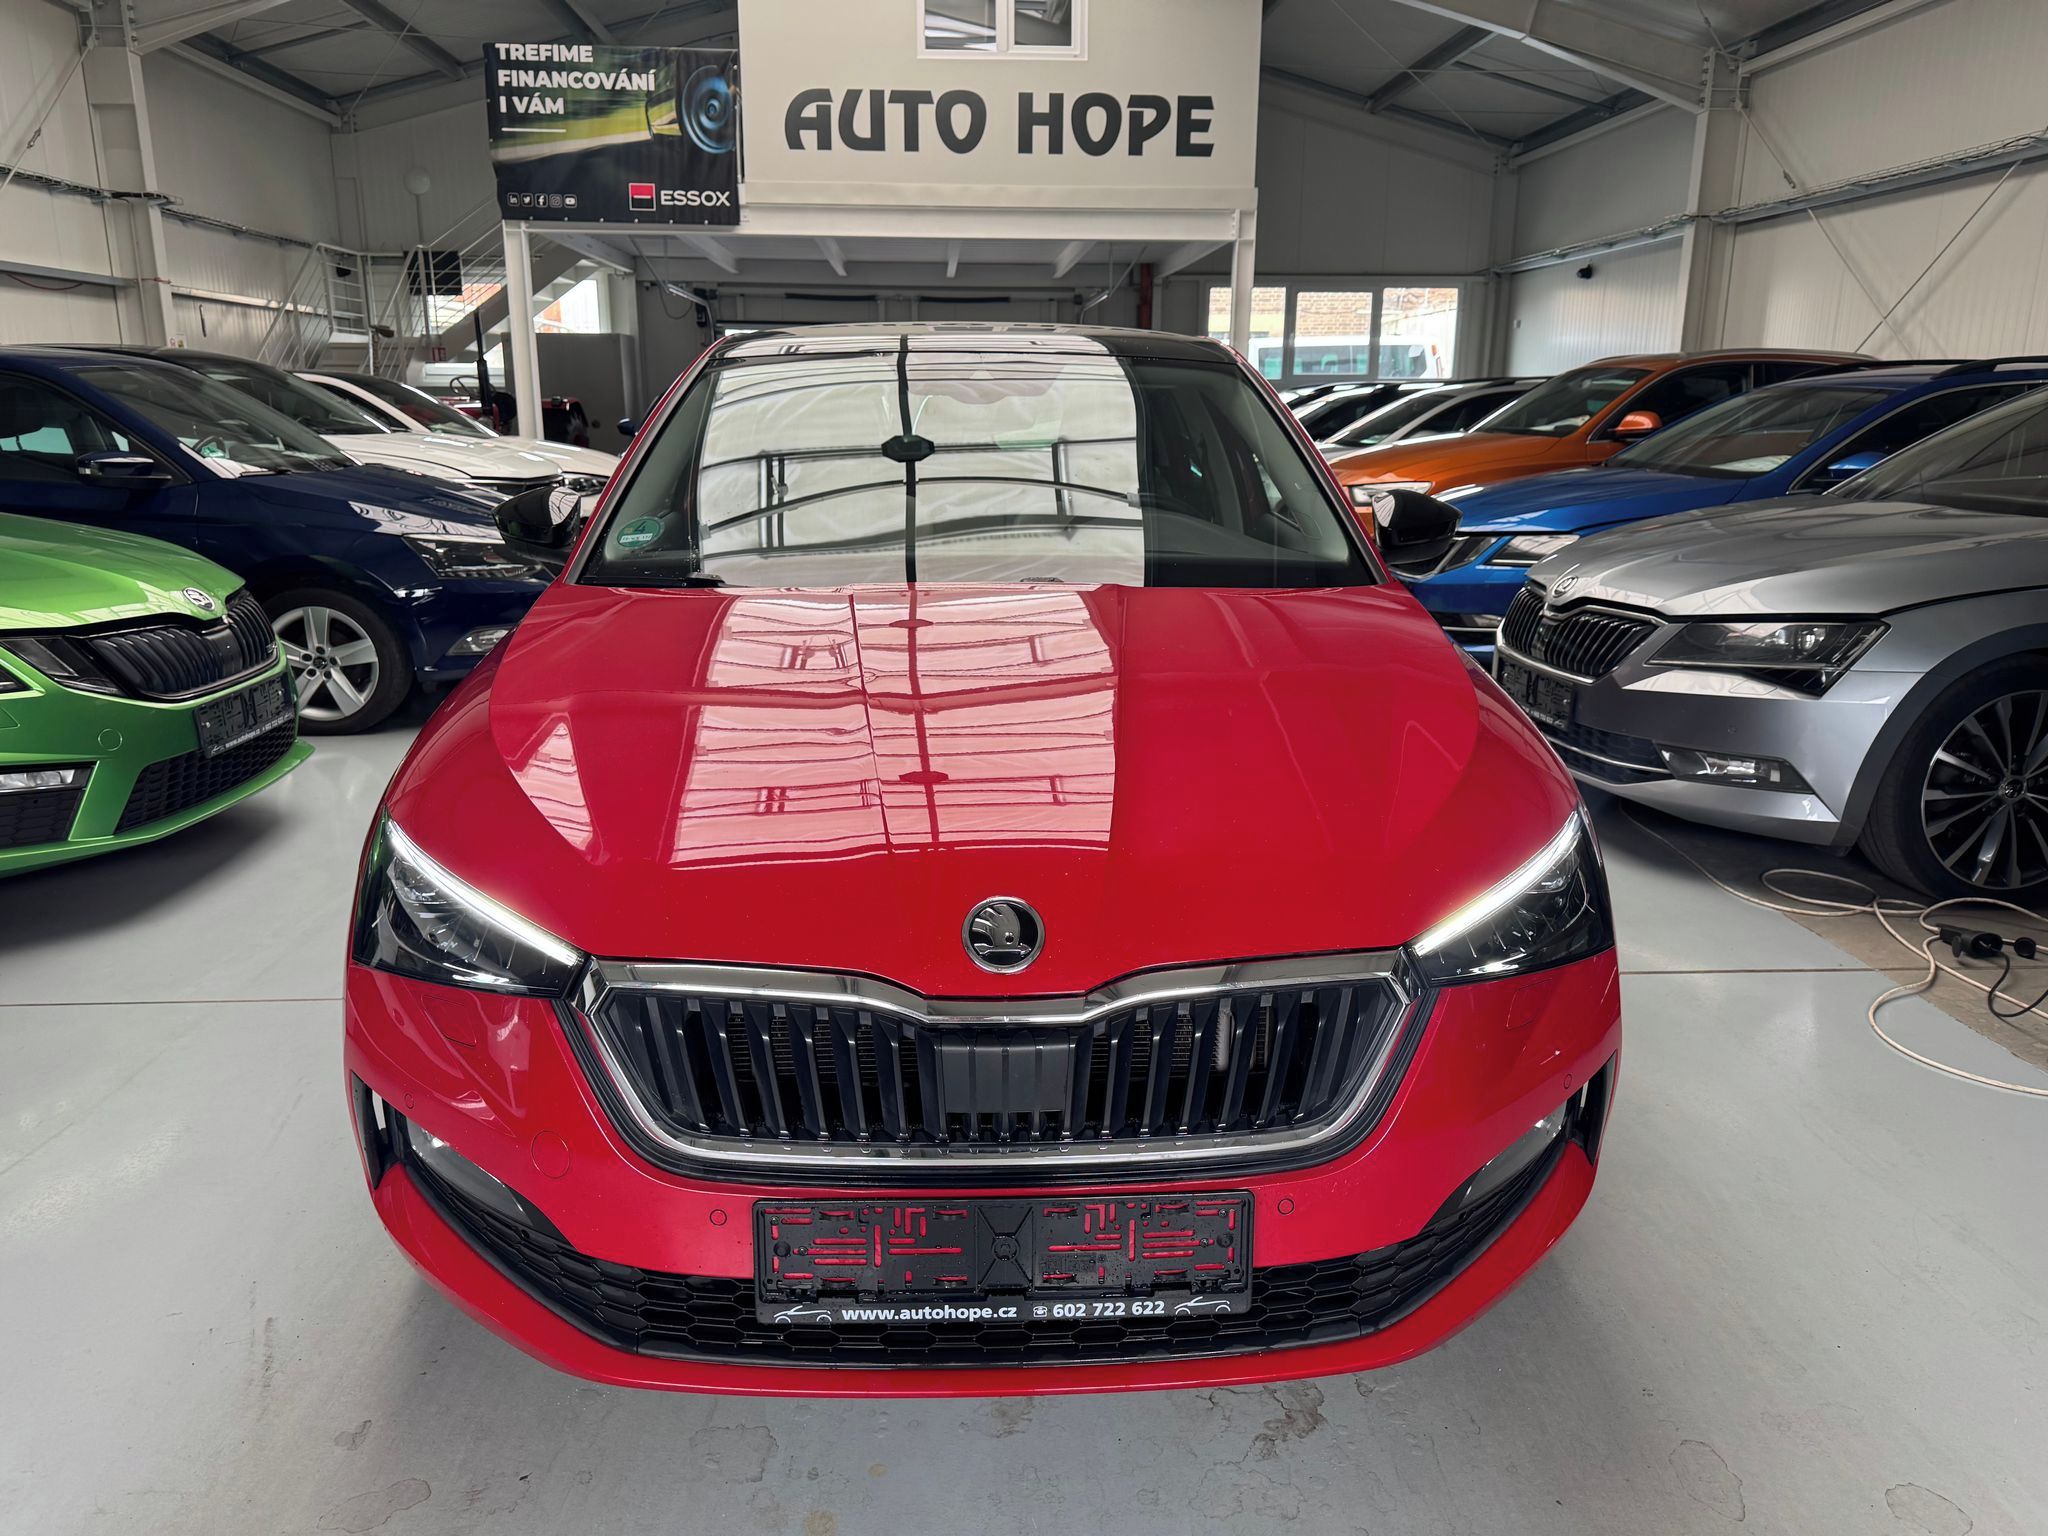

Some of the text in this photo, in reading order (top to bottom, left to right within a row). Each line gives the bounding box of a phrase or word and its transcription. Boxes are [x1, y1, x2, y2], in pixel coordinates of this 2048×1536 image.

[495, 43, 593, 62] TREFIME
[497, 69, 656, 91] FINANCOVÁNÍ
[500, 96, 565, 115] I VÁM
[784, 88, 1214, 157] AUTO HOPE
[660, 190, 731, 207] ESSOX
[842, 1301, 1165, 1321] www.autohope.cz 602 722 622
